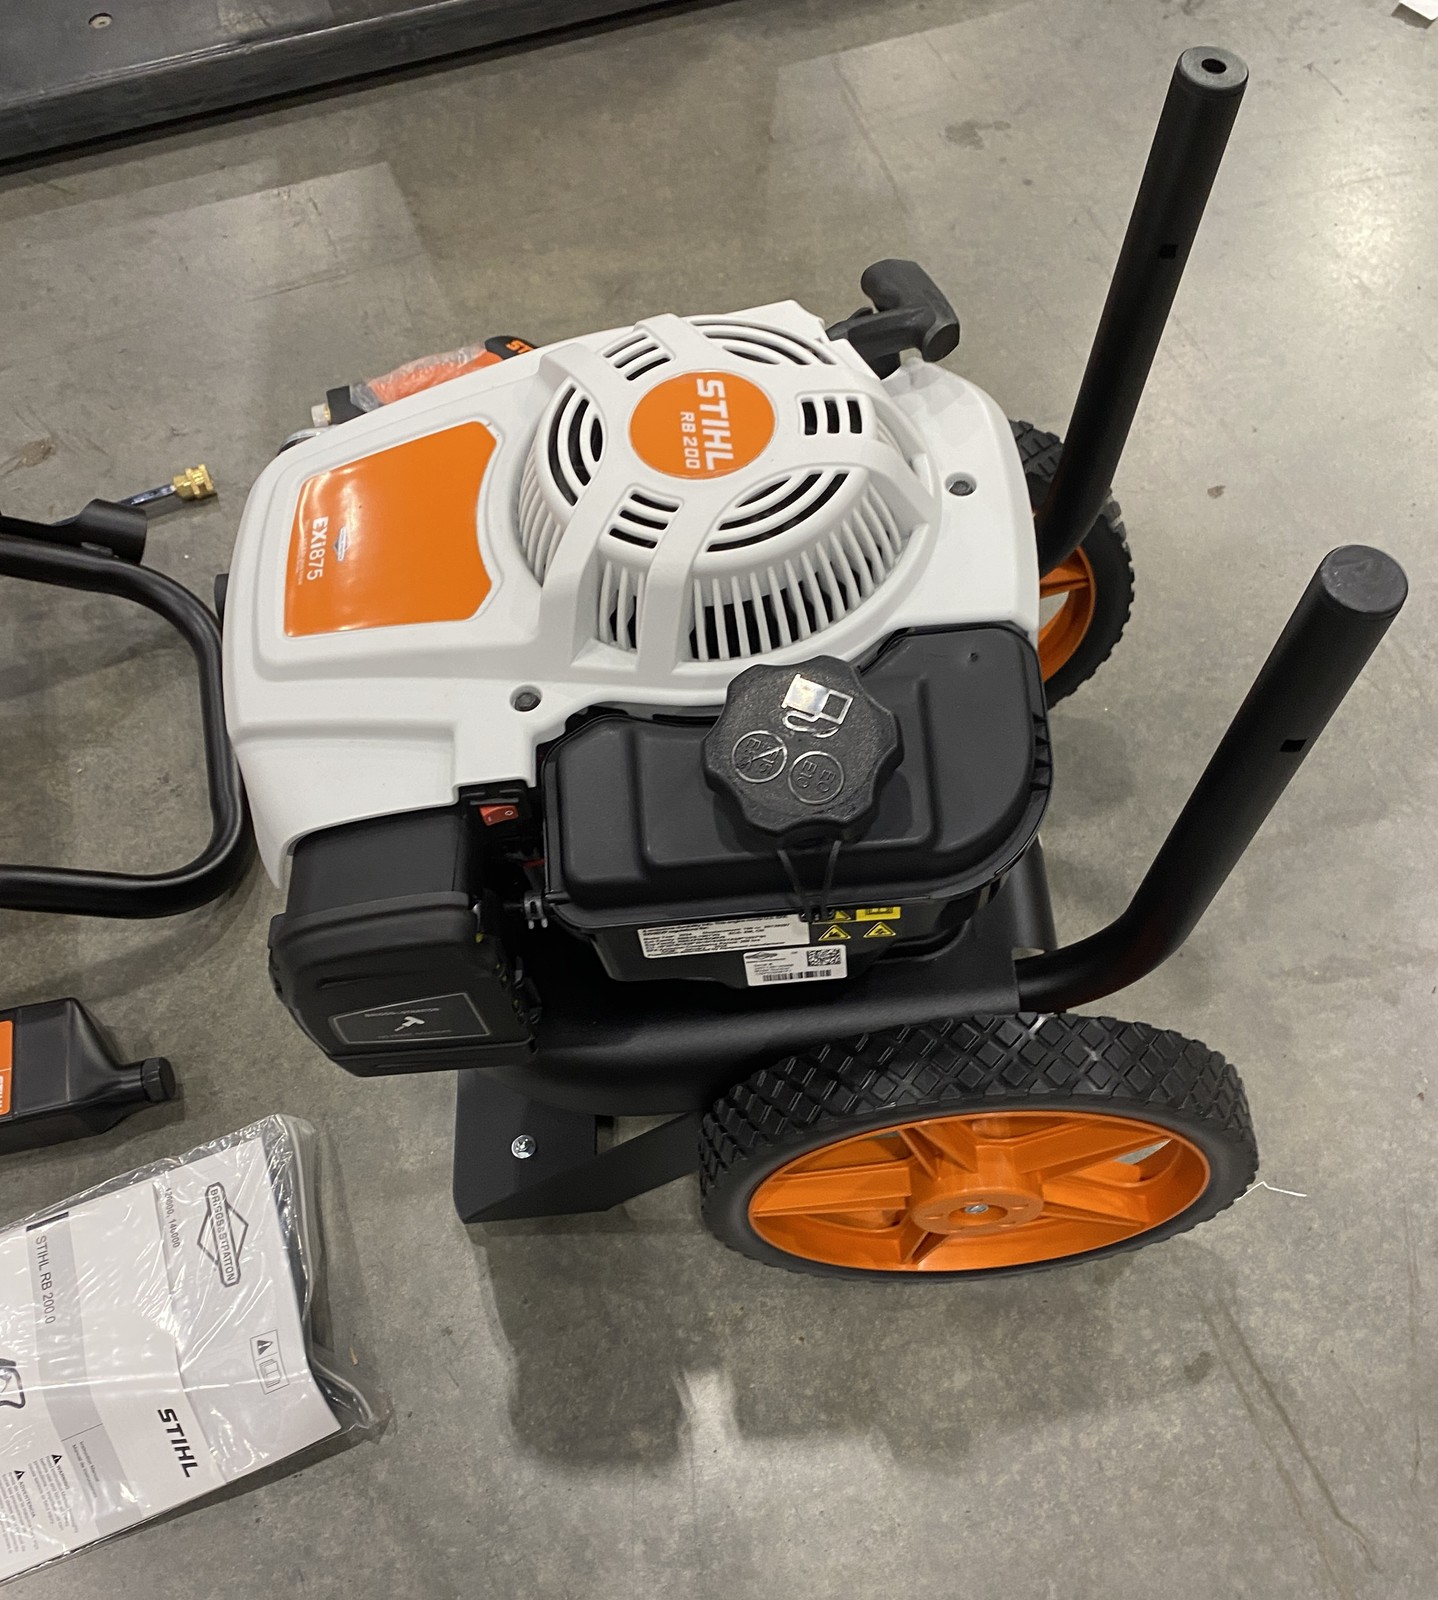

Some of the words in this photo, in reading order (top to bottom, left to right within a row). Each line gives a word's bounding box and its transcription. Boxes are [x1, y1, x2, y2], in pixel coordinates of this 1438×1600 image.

[680, 411, 697, 433] RB
[696, 379, 734, 470] STIHL
[682, 436, 701, 469] 200
[36, 1235, 49, 1271] STIHL
[40, 1272, 52, 1290] RB
[43, 1292, 56, 1324] 200.0
[157, 1407, 201, 1478] STIHL
